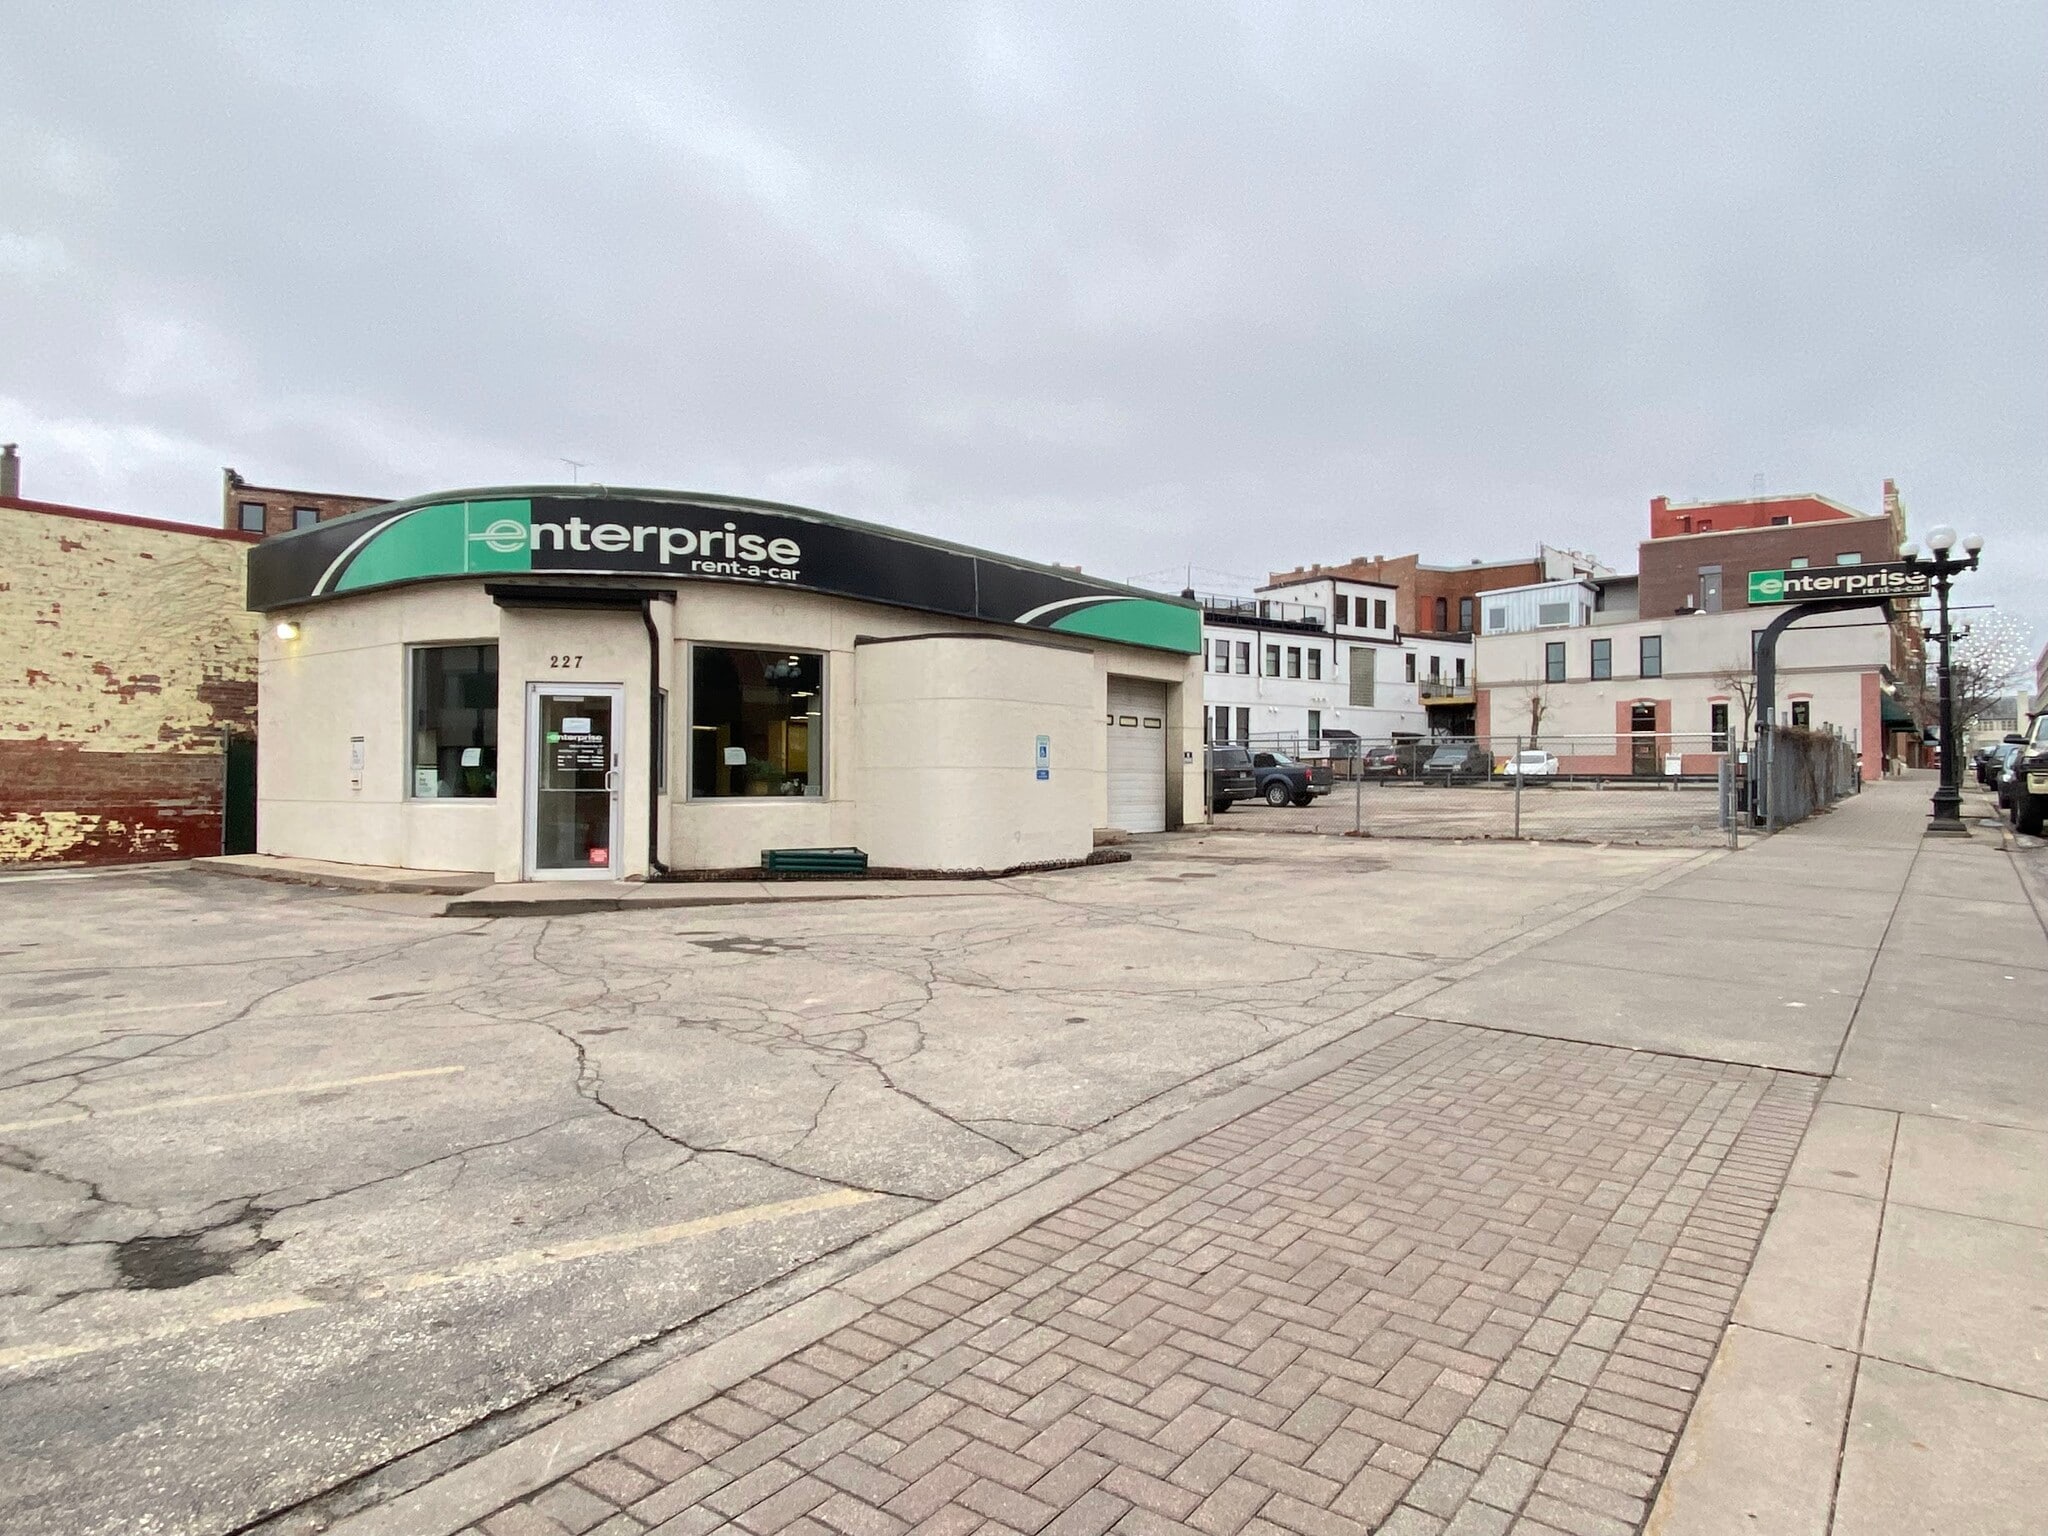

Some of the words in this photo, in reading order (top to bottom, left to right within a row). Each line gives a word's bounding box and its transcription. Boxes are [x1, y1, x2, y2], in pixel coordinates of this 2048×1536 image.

[470, 516, 801, 564] enterprise
[691, 559, 801, 580] rent-a-car
[1752, 568, 1927, 595] enterprise
[1862, 584, 1927, 594] rent-a-car
[550, 655, 583, 669] 227
